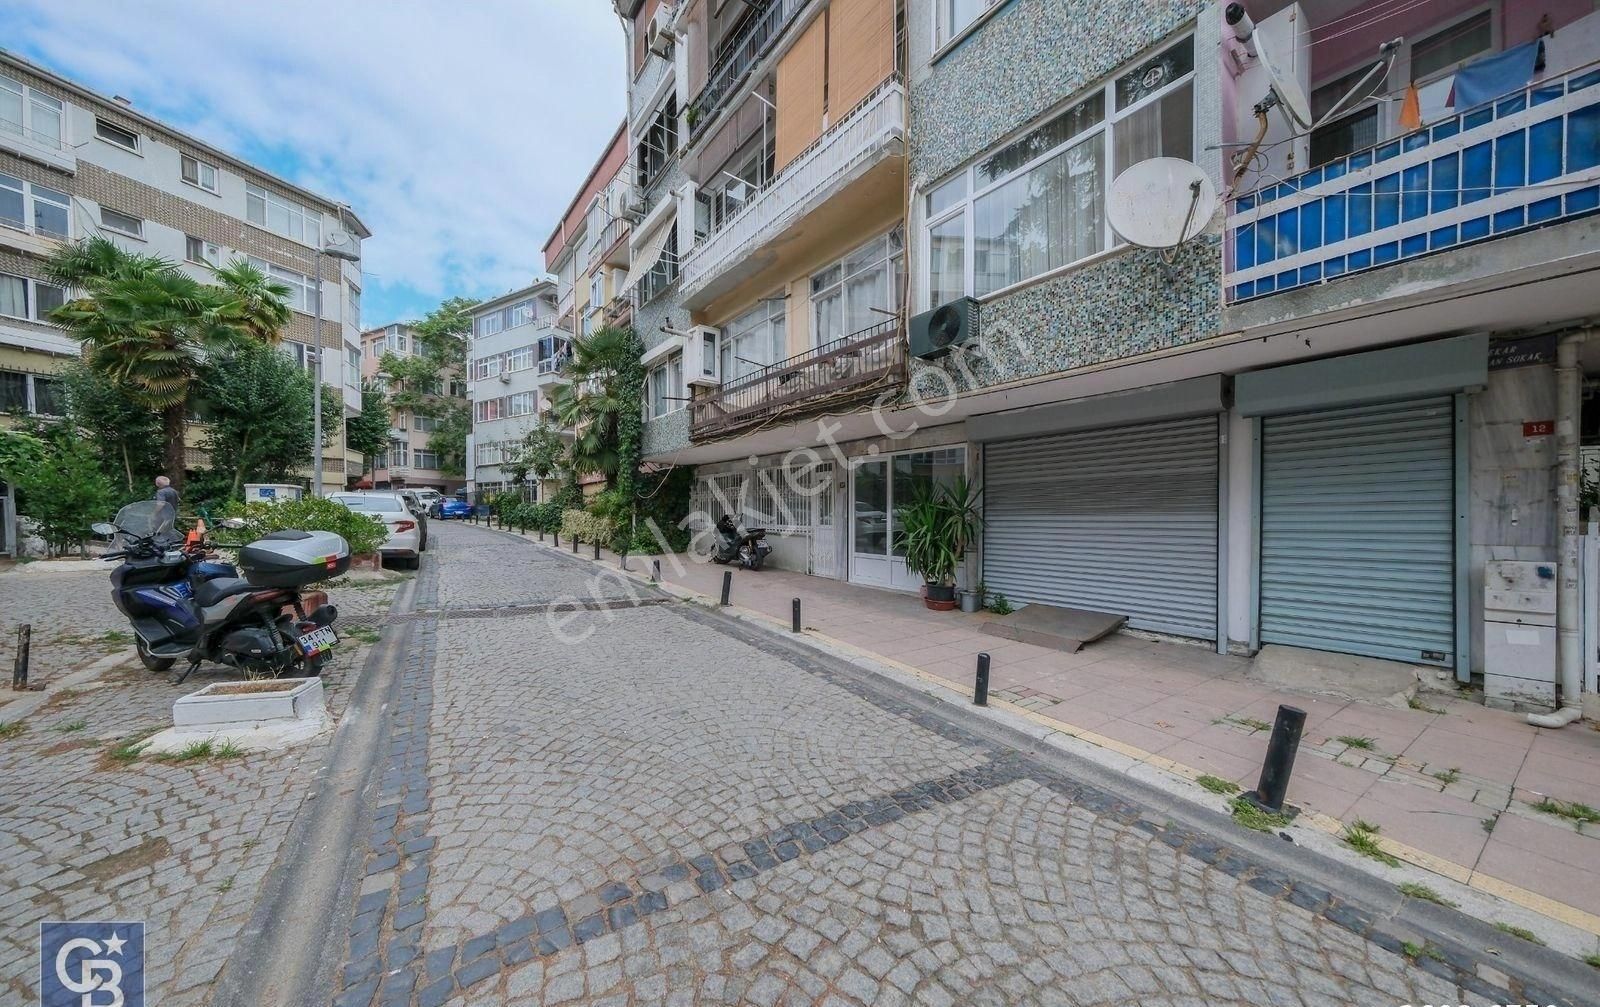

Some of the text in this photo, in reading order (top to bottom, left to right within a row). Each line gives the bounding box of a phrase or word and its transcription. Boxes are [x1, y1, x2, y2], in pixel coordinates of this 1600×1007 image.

[1507, 353, 1541, 363] SOKAK
[1532, 424, 1546, 433] 12
[301, 635, 314, 644] 34
[312, 638, 328, 648] 911
